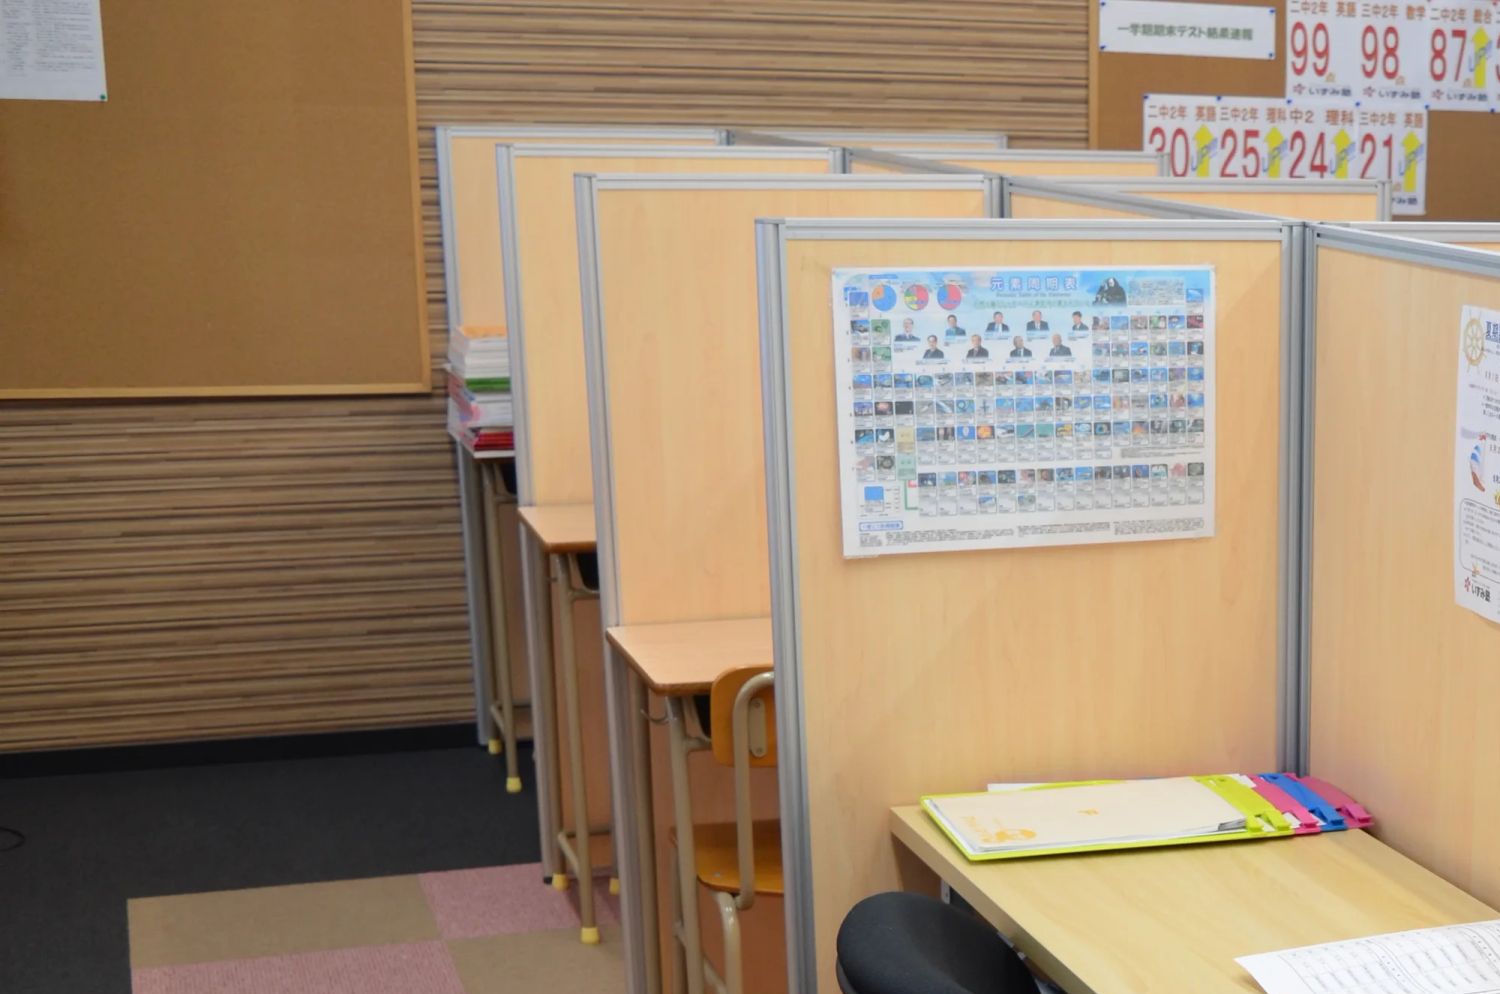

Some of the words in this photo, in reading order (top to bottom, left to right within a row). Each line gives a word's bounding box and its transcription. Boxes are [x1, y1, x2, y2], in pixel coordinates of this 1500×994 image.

[1291, 21, 1329, 76] 99
[1361, 25, 1399, 79] 98
[1430, 28, 1467, 82] 87
[1220, 128, 1261, 178] 25
[1289, 130, 1329, 179] 24
[1360, 133, 1393, 180] 21
